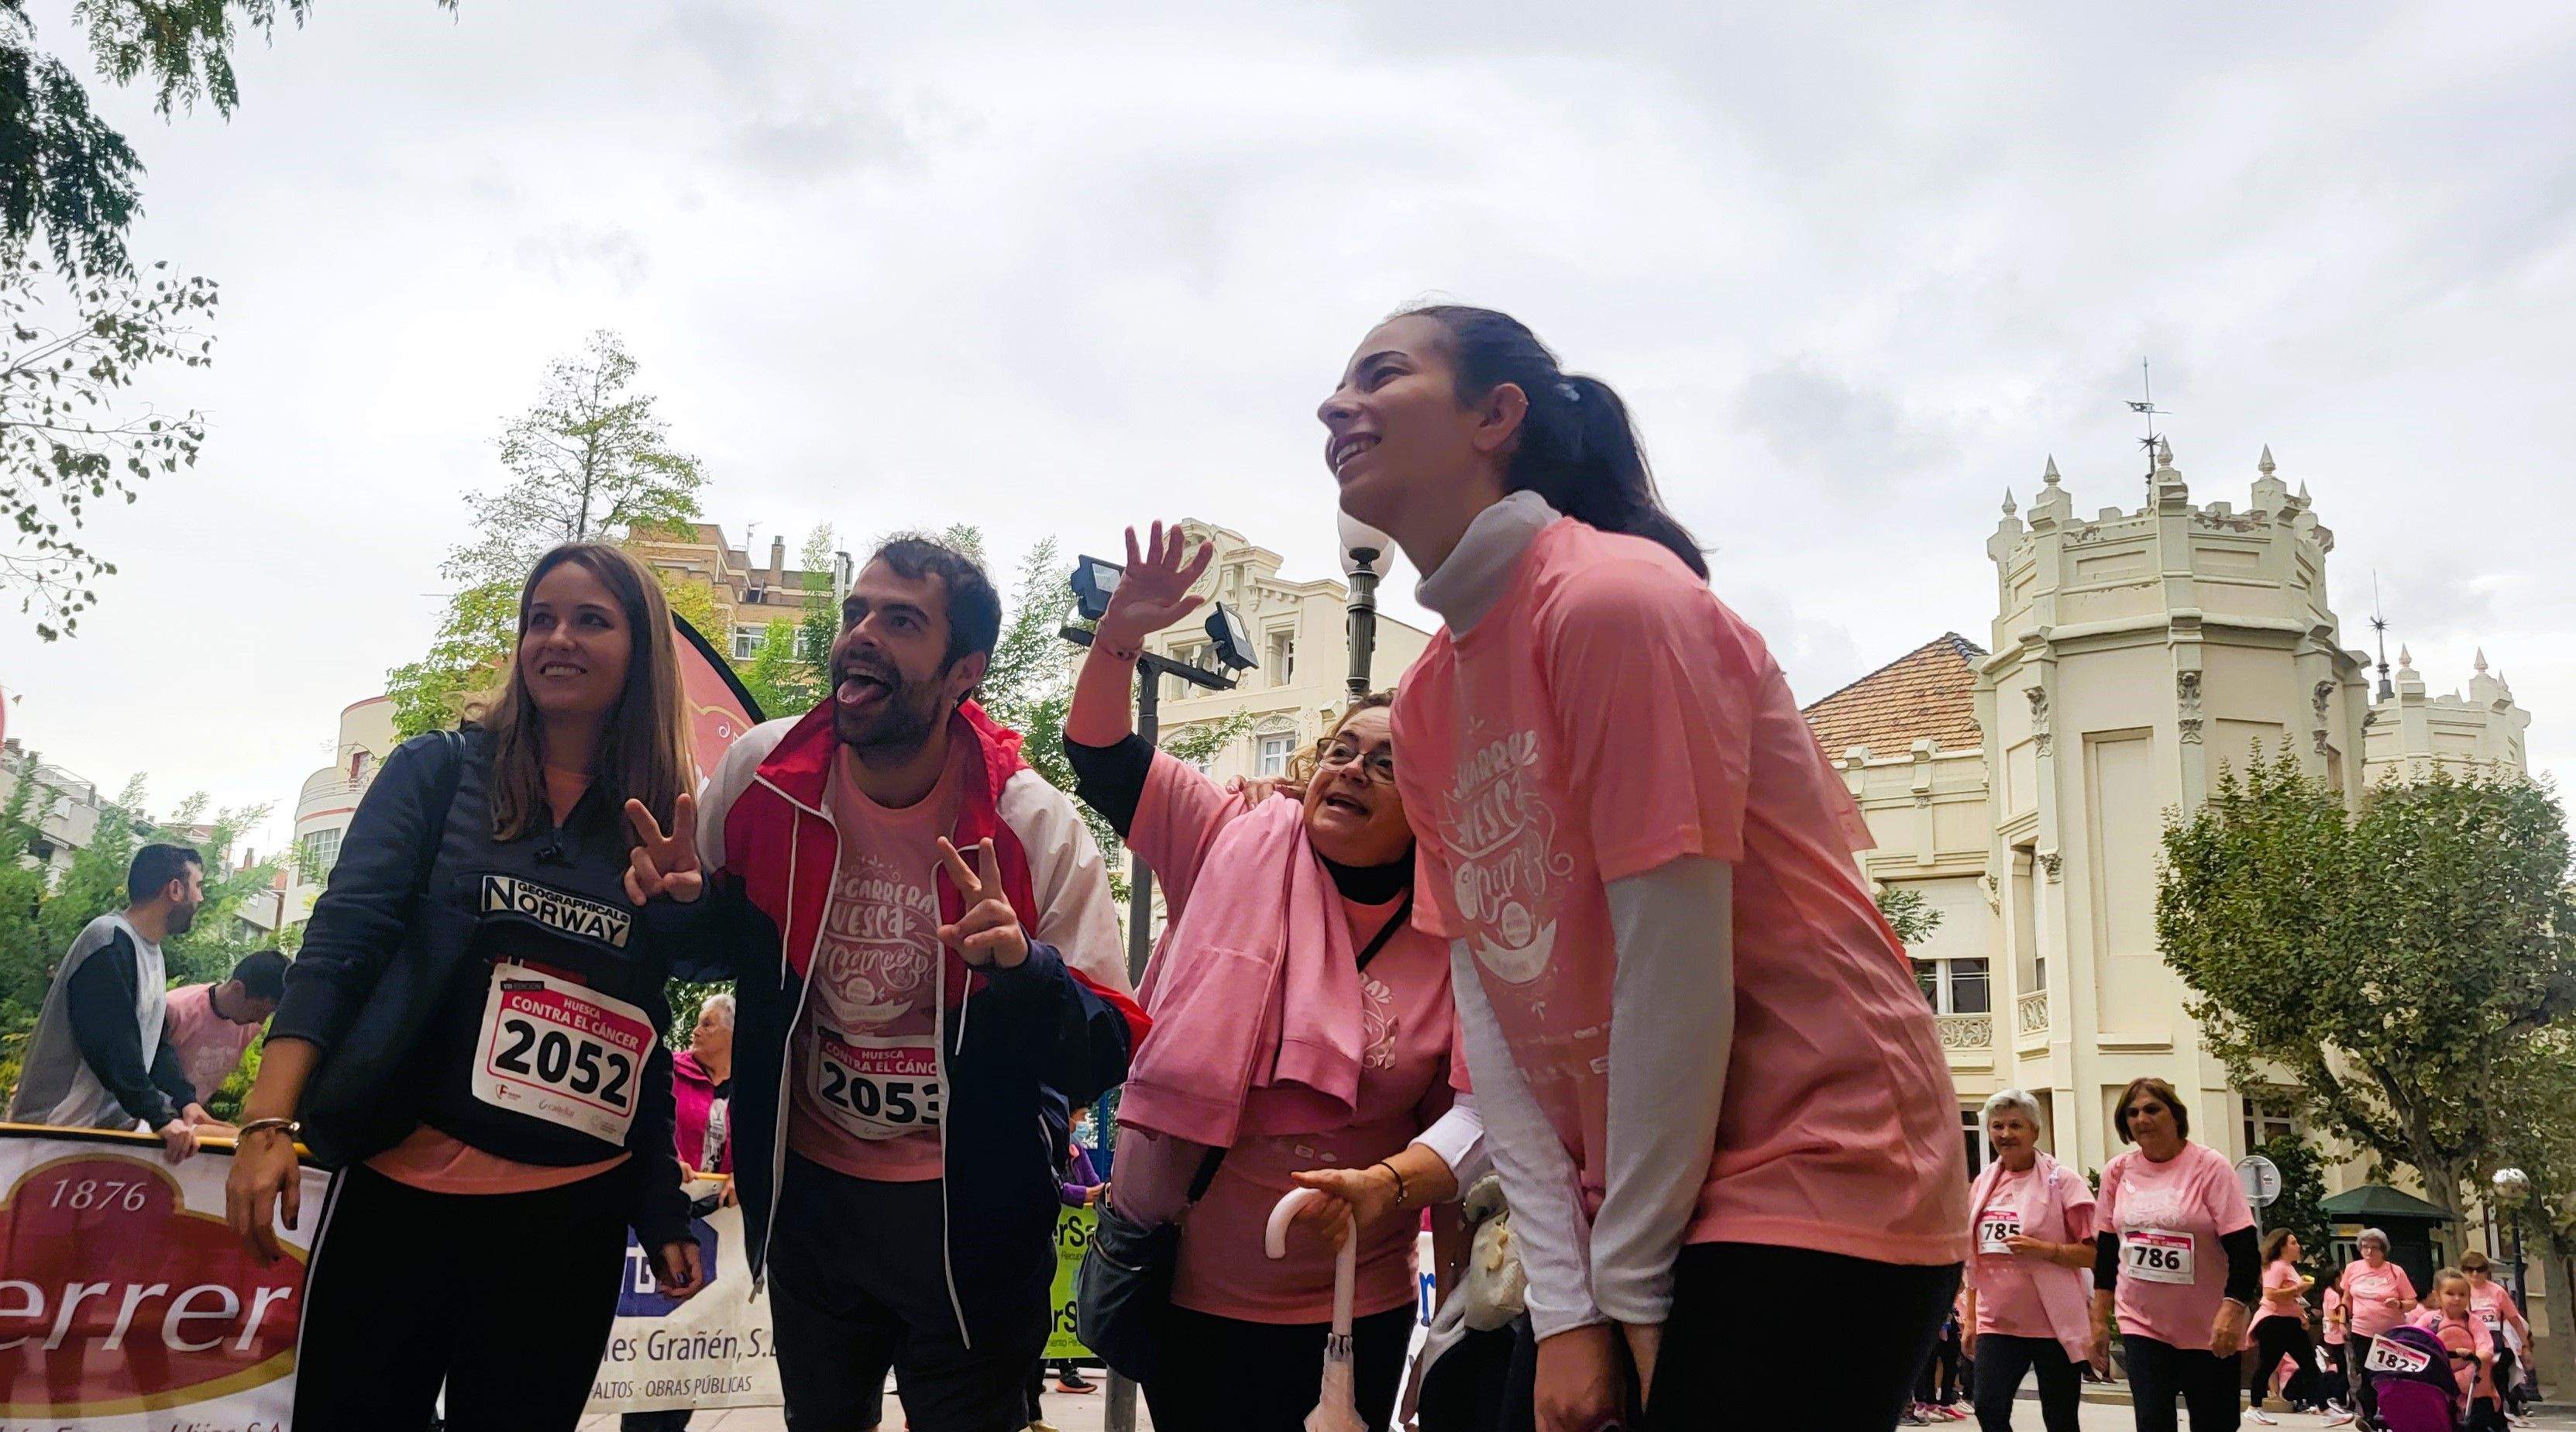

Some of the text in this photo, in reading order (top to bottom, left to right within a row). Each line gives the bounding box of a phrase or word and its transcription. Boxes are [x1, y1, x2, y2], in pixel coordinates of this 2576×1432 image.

[485, 876, 624, 942] NORWAY
[511, 996, 639, 1050] CONTRA EL CÁNCER
[563, 998, 600, 1019] HUESCA
[495, 1019, 631, 1108] 2052
[825, 1041, 872, 1072] CONTRA
[876, 1062, 890, 1072] EL
[862, 1050, 905, 1060] HUESCA
[822, 1061, 940, 1124] 2053
[51, 1179, 148, 1211] 1876
[1984, 1223, 2021, 1241] 785
[2134, 1246, 2180, 1270] 786
[0, 1279, 293, 1352] errer
[648, 1329, 741, 1363] Grañén,
[591, 1375, 753, 1399] ALTOS OBRAS PÚBLICAS
